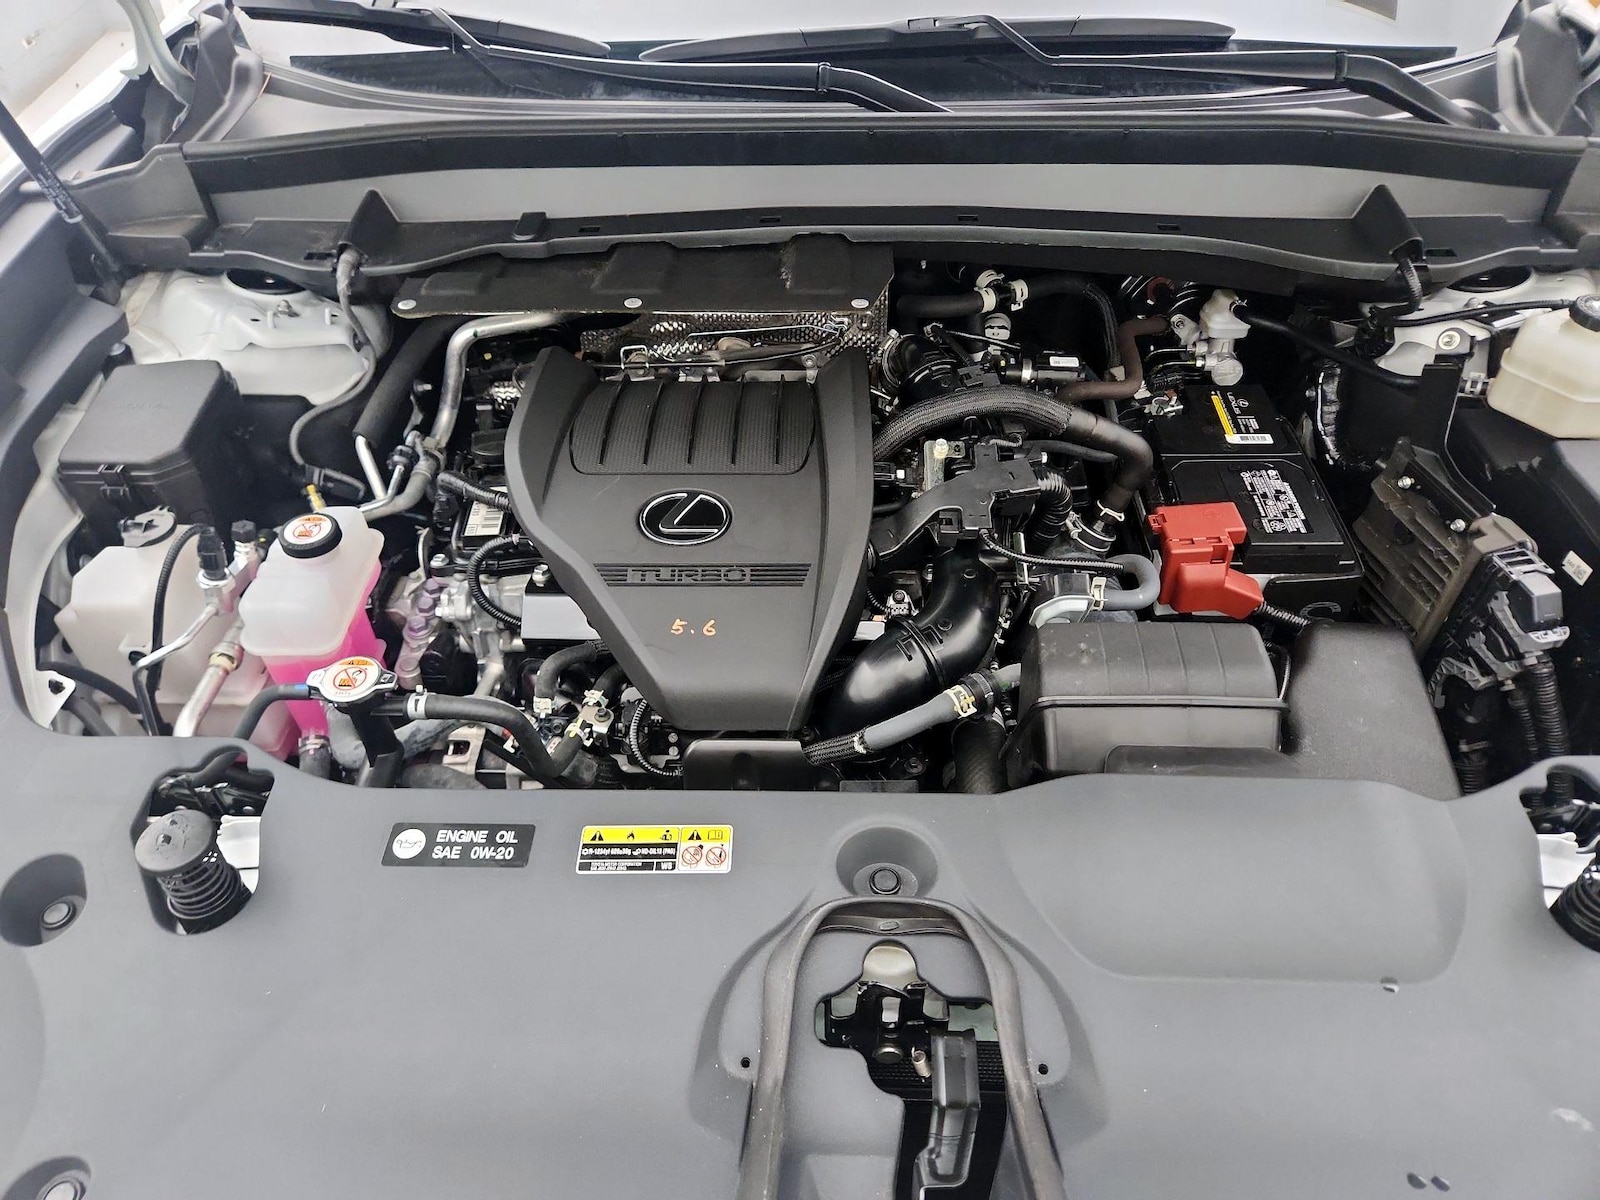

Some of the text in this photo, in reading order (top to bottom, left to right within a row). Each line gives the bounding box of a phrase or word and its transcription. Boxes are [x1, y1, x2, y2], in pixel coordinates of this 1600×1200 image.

[1227, 392, 1241, 414] LEXUS
[631, 568, 746, 582] TURBO
[436, 830, 518, 843] ENGINE OIL
[432, 846, 515, 860] SAE 0W-20
